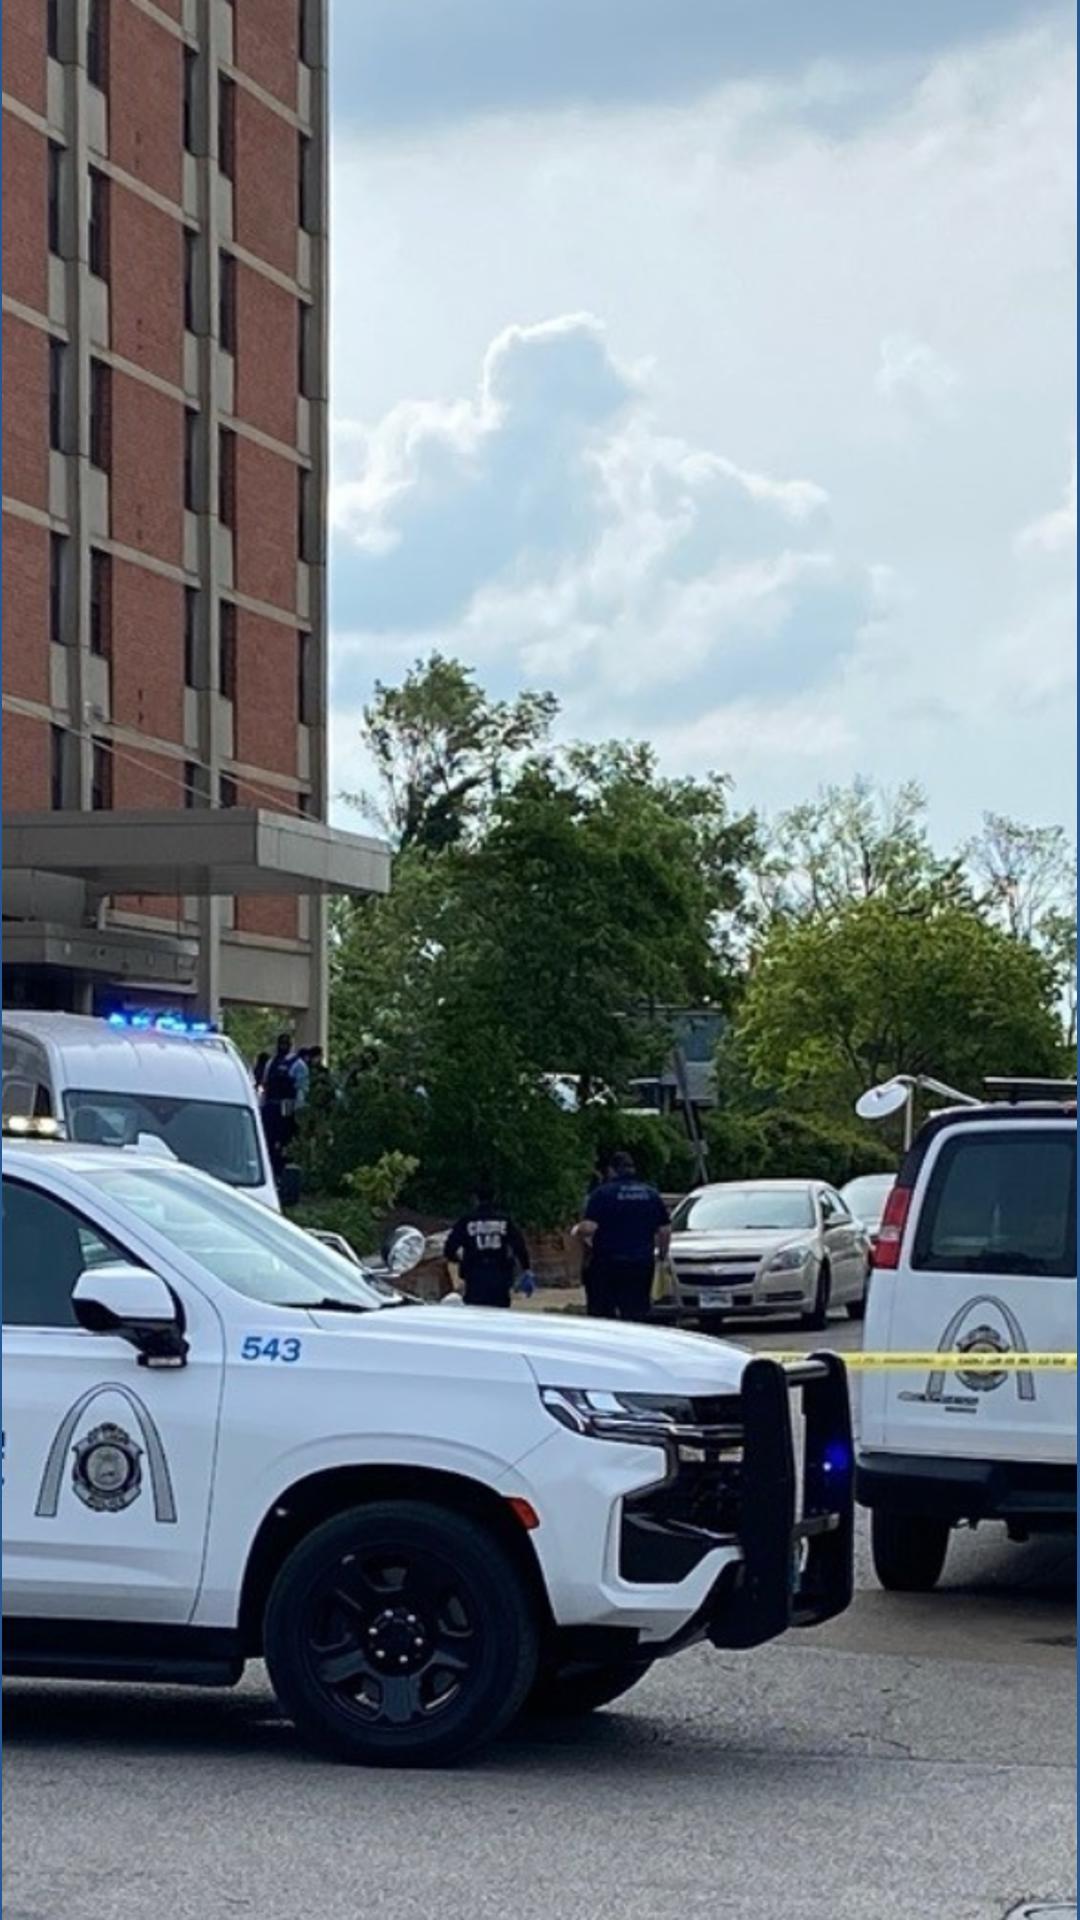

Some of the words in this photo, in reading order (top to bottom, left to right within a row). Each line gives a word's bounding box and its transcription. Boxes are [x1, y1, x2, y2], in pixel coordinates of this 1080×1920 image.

[467, 1220, 508, 1236] CRIME
[476, 1235, 502, 1250] LAB
[241, 1336, 302, 1362] 543
